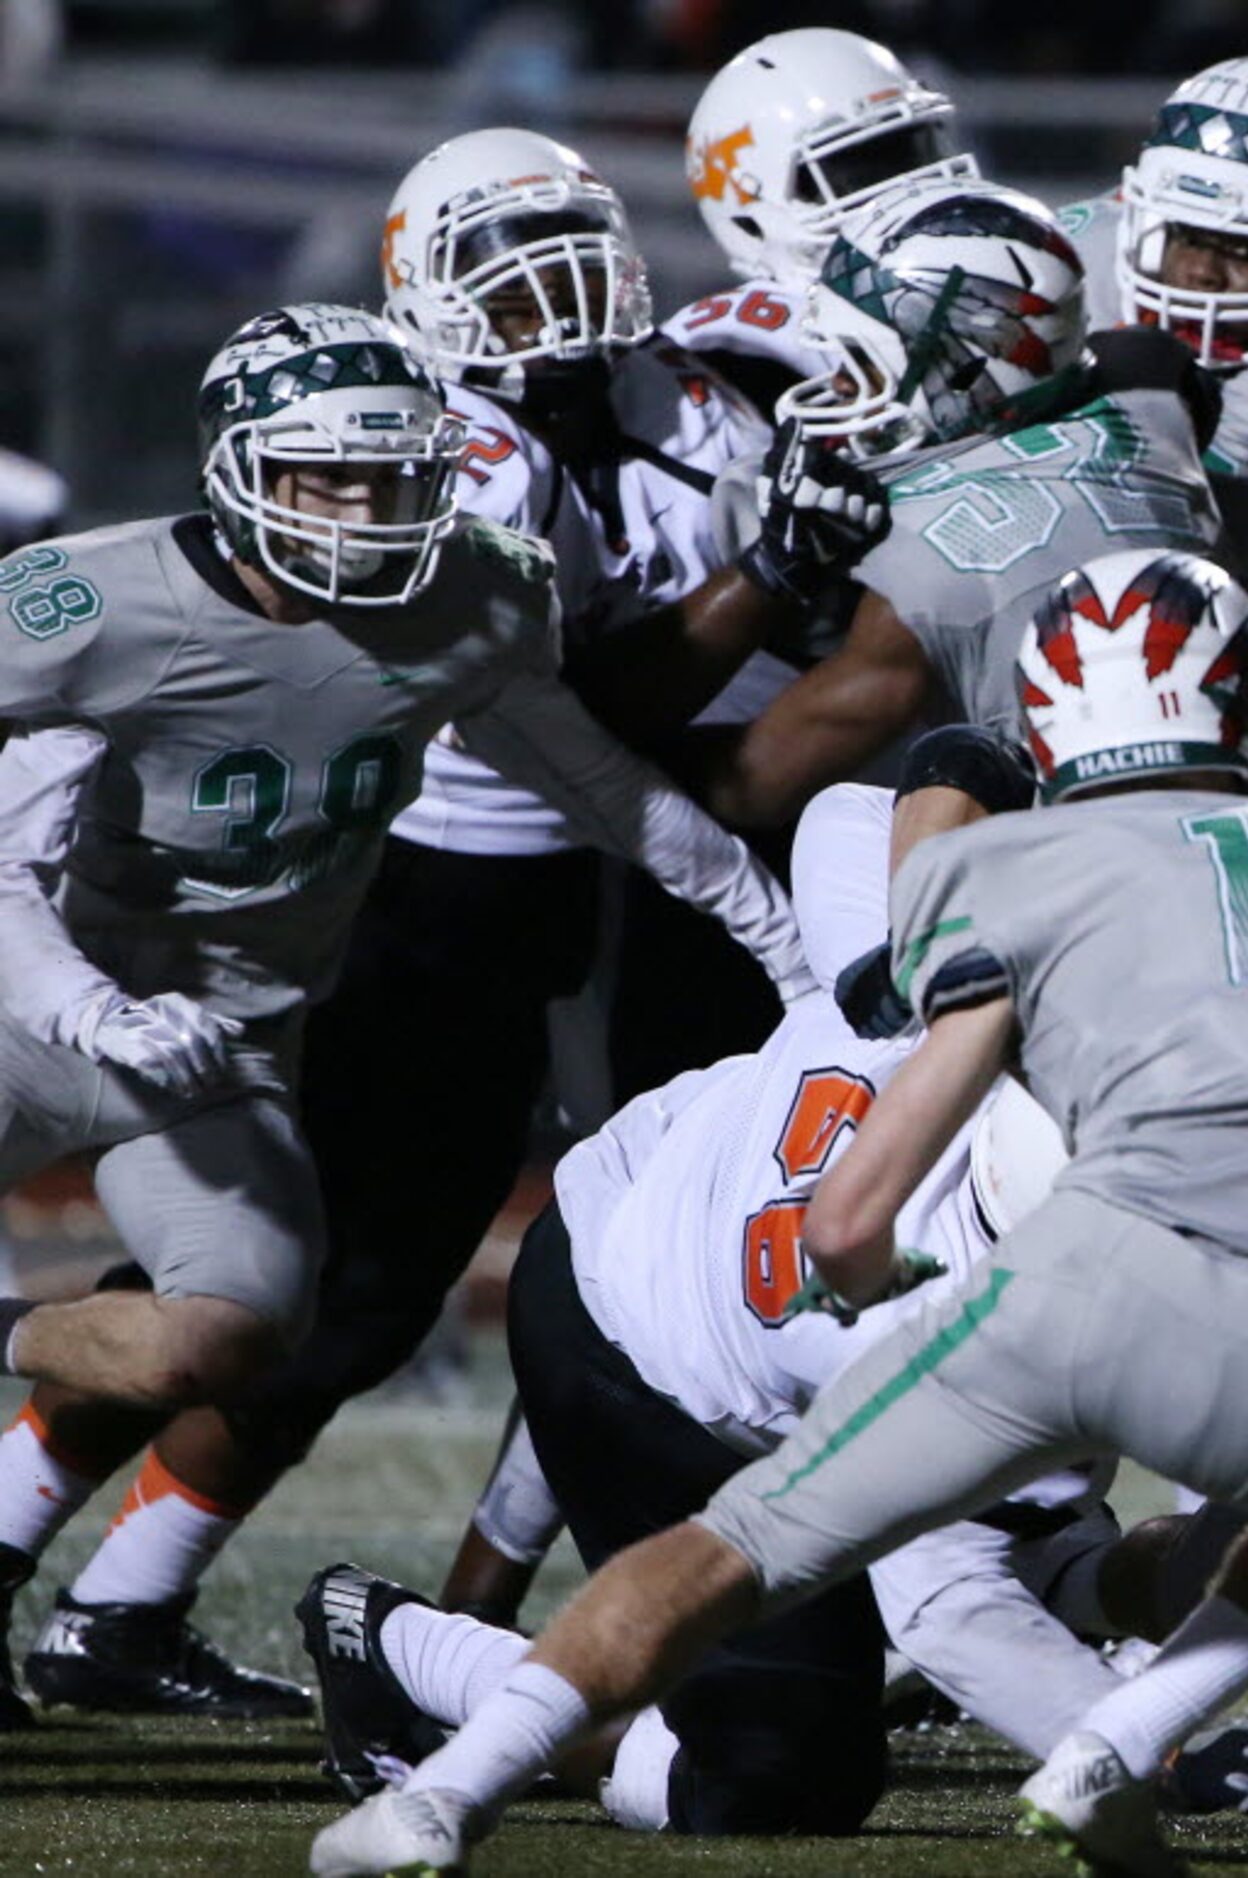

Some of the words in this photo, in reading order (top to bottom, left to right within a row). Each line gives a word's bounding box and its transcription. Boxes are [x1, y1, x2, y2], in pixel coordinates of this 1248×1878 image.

[1158, 690, 1181, 719] 11
[1075, 743, 1186, 780] HACHIE
[322, 1568, 370, 1663] NIKE
